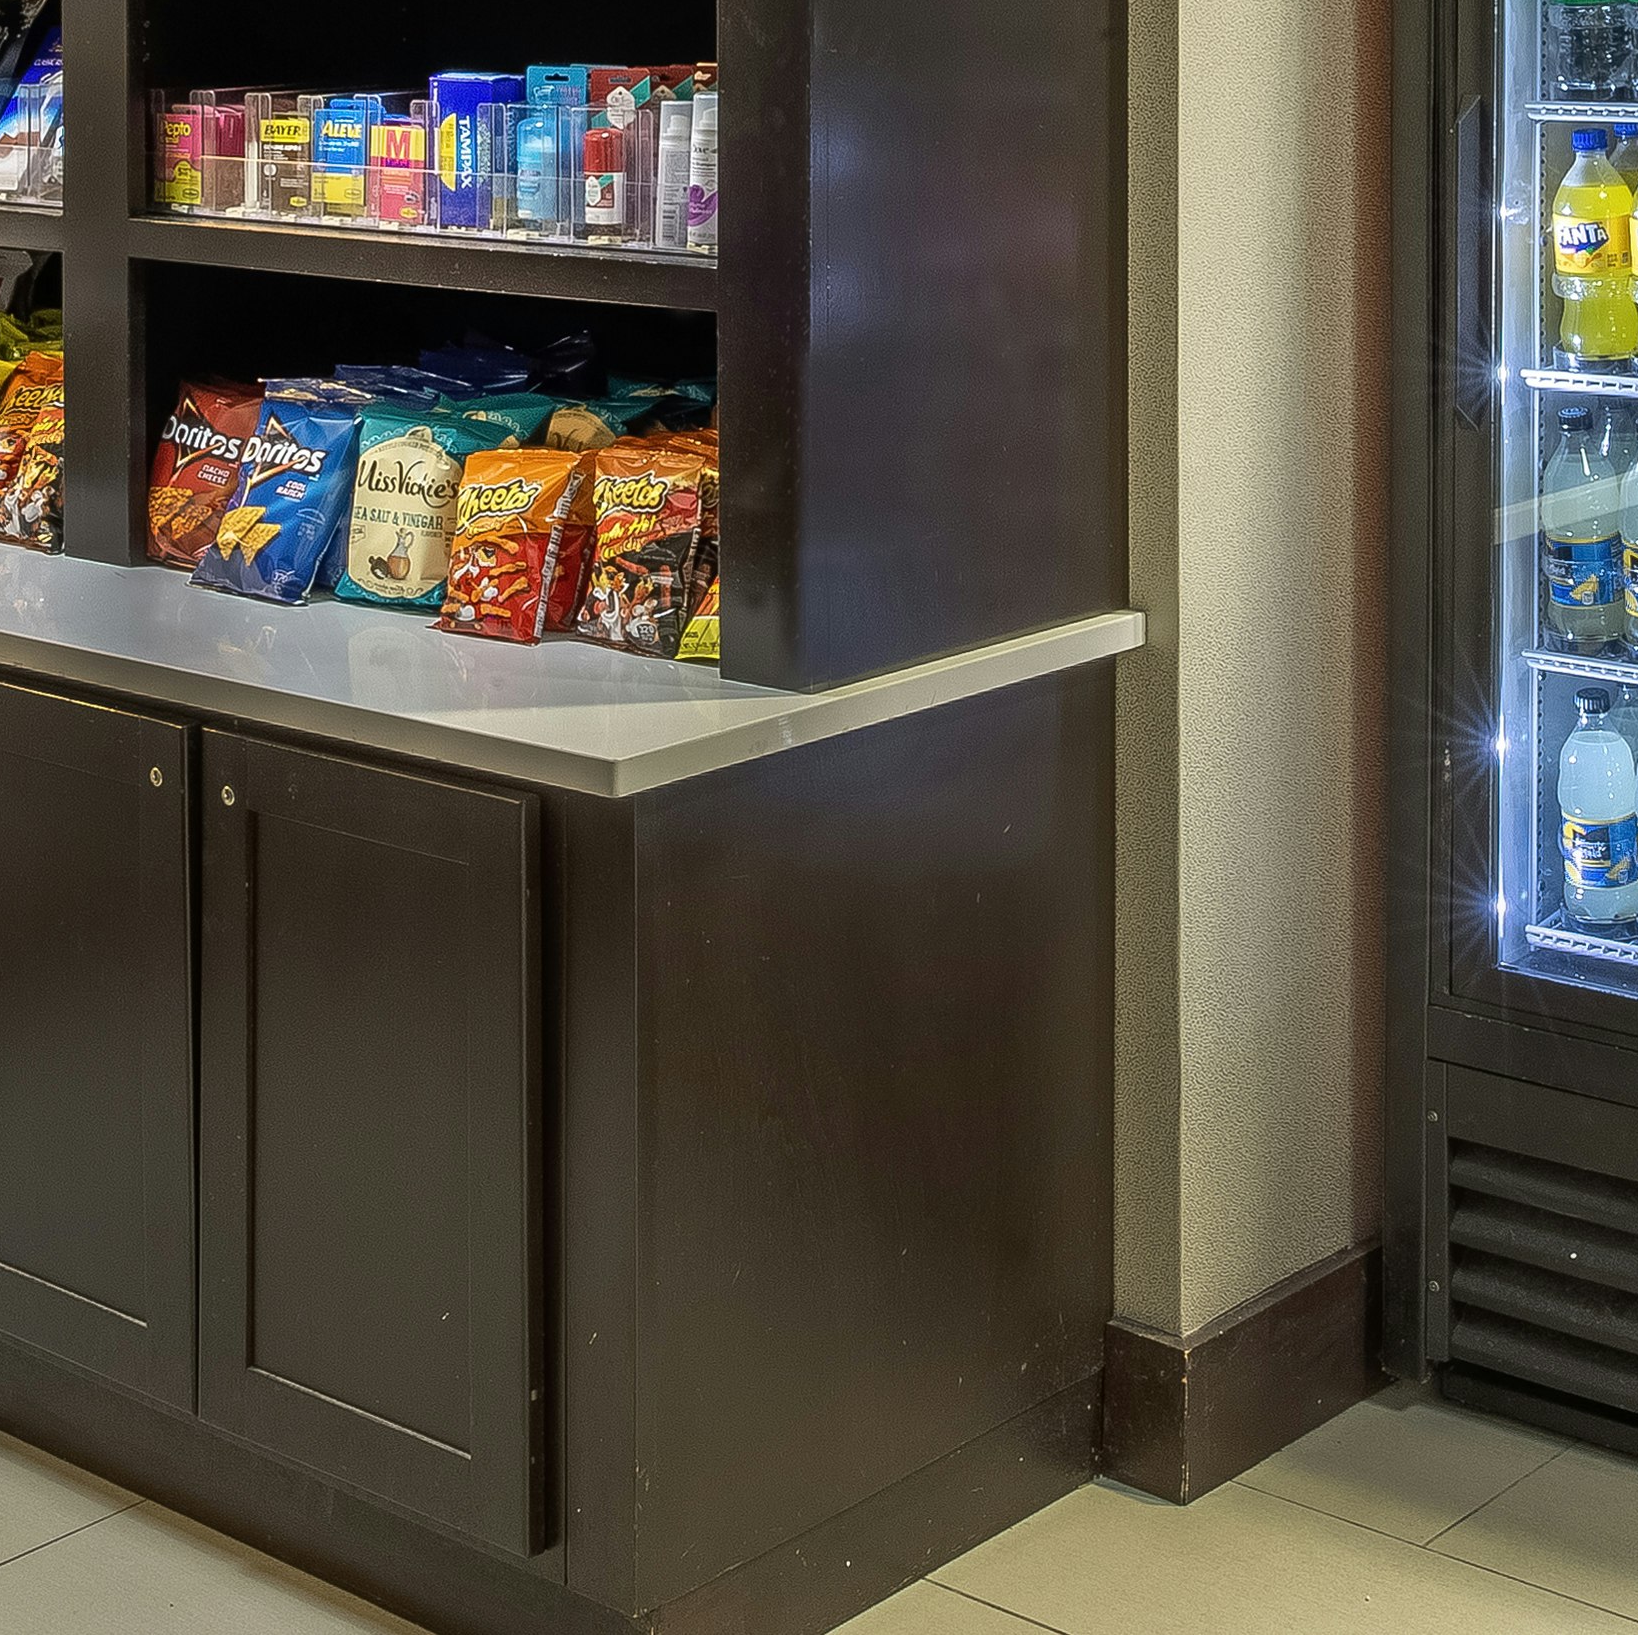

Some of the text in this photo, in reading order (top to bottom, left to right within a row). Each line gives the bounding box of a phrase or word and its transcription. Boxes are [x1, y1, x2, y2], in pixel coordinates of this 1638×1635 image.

[263, 124, 302, 137] BAYER
[458, 116, 473, 189] TAMPAX
[162, 414, 243, 466] Doritos
[241, 437, 327, 473] Doritos
[197, 471, 228, 486] CHEESE
[201, 463, 231, 478] NACHO
[276, 485, 305, 500] RANCH
[285, 479, 307, 491] COOL
[396, 460, 460, 509] Vickie's
[593, 473, 667, 514] Cheetos
[370, 509, 390, 524] SALT
[391, 512, 399, 526] &
[402, 513, 444, 531] VINEGAR
[631, 514, 657, 533] Hot
